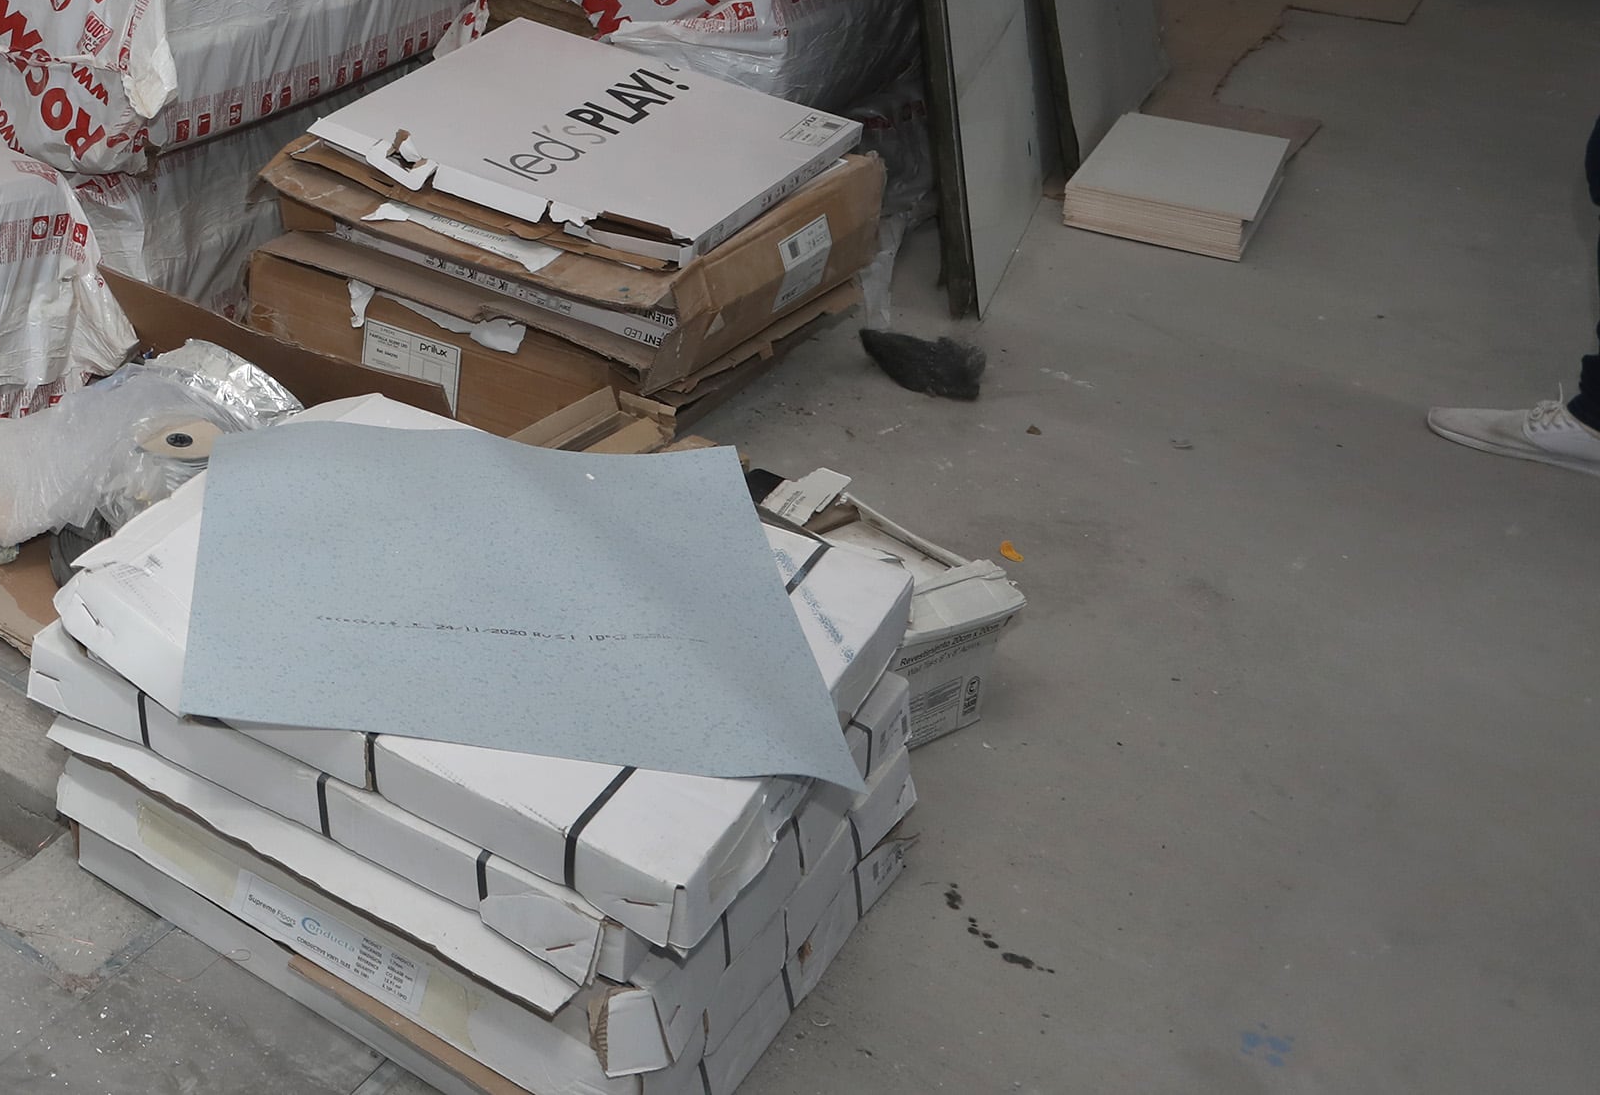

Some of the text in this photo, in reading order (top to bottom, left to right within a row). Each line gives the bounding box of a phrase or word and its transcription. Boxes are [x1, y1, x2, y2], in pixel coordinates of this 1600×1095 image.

[482, 66, 691, 183] led's PLAY!
[419, 343, 448, 358] prilux
[624, 325, 663, 349] ENT LED
[248, 894, 297, 926] Supreme Floors
[301, 916, 356, 953] Conducta
